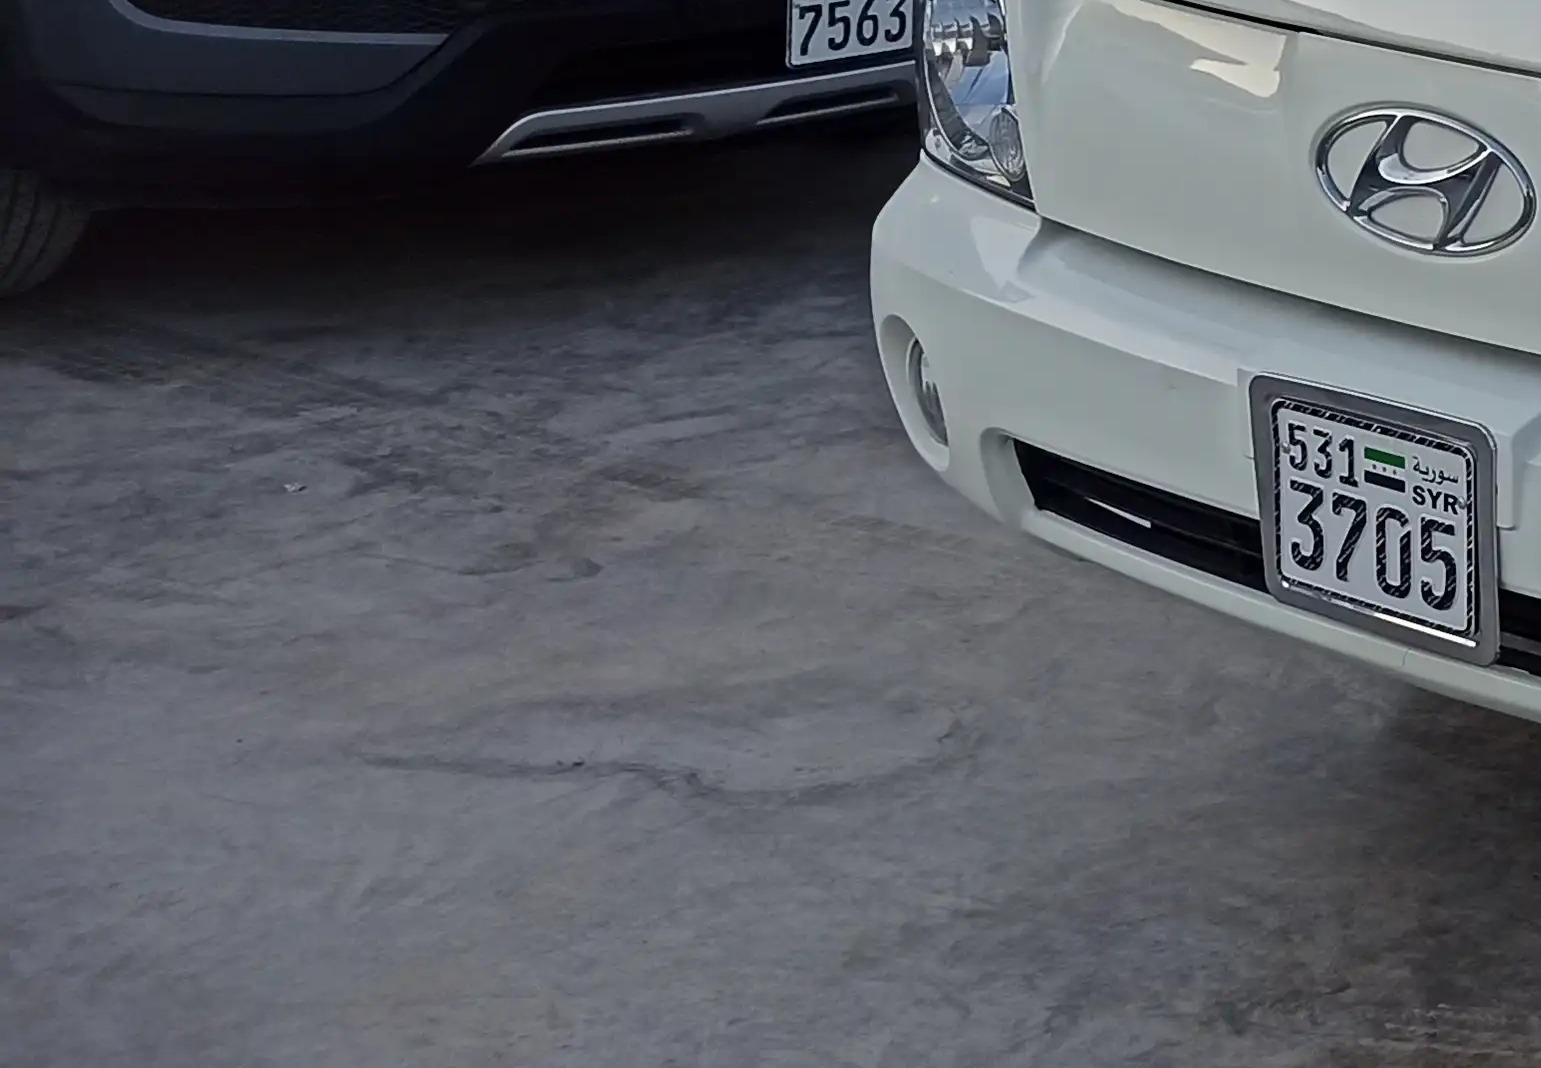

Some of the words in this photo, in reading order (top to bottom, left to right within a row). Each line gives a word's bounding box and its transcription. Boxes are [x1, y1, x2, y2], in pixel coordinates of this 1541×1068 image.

[1286, 421, 1360, 488] 531
[1411, 455, 1460, 485] سورية
[1411, 484, 1460, 516] SYR
[1288, 478, 1459, 612] 3705
